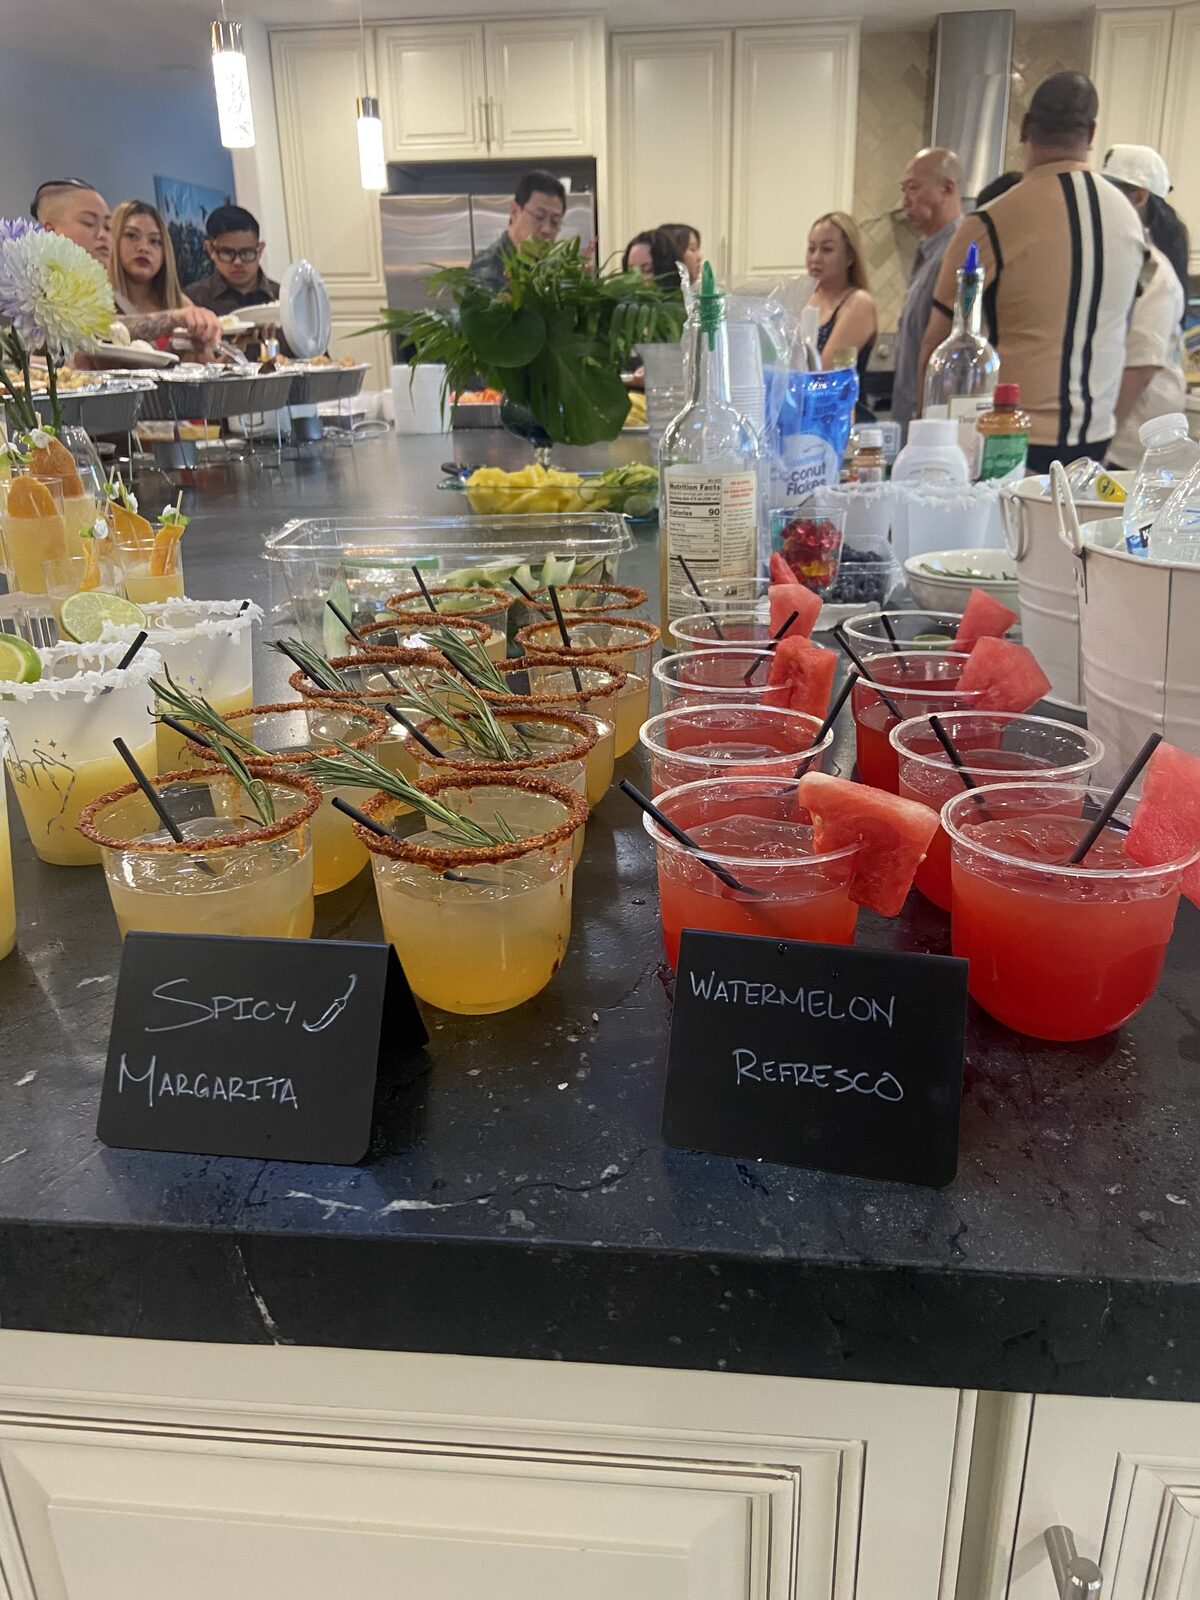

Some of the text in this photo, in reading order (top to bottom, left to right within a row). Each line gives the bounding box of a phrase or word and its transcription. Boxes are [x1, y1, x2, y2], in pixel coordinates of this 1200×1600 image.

[669, 483, 698, 491] Nutrition
[708, 508, 720, 516] 90
[144, 977, 297, 1032] SPICY
[689, 970, 896, 1029] WATERMELON
[117, 1052, 299, 1111] MARGARITA
[732, 1047, 904, 1102] REFRESCO
